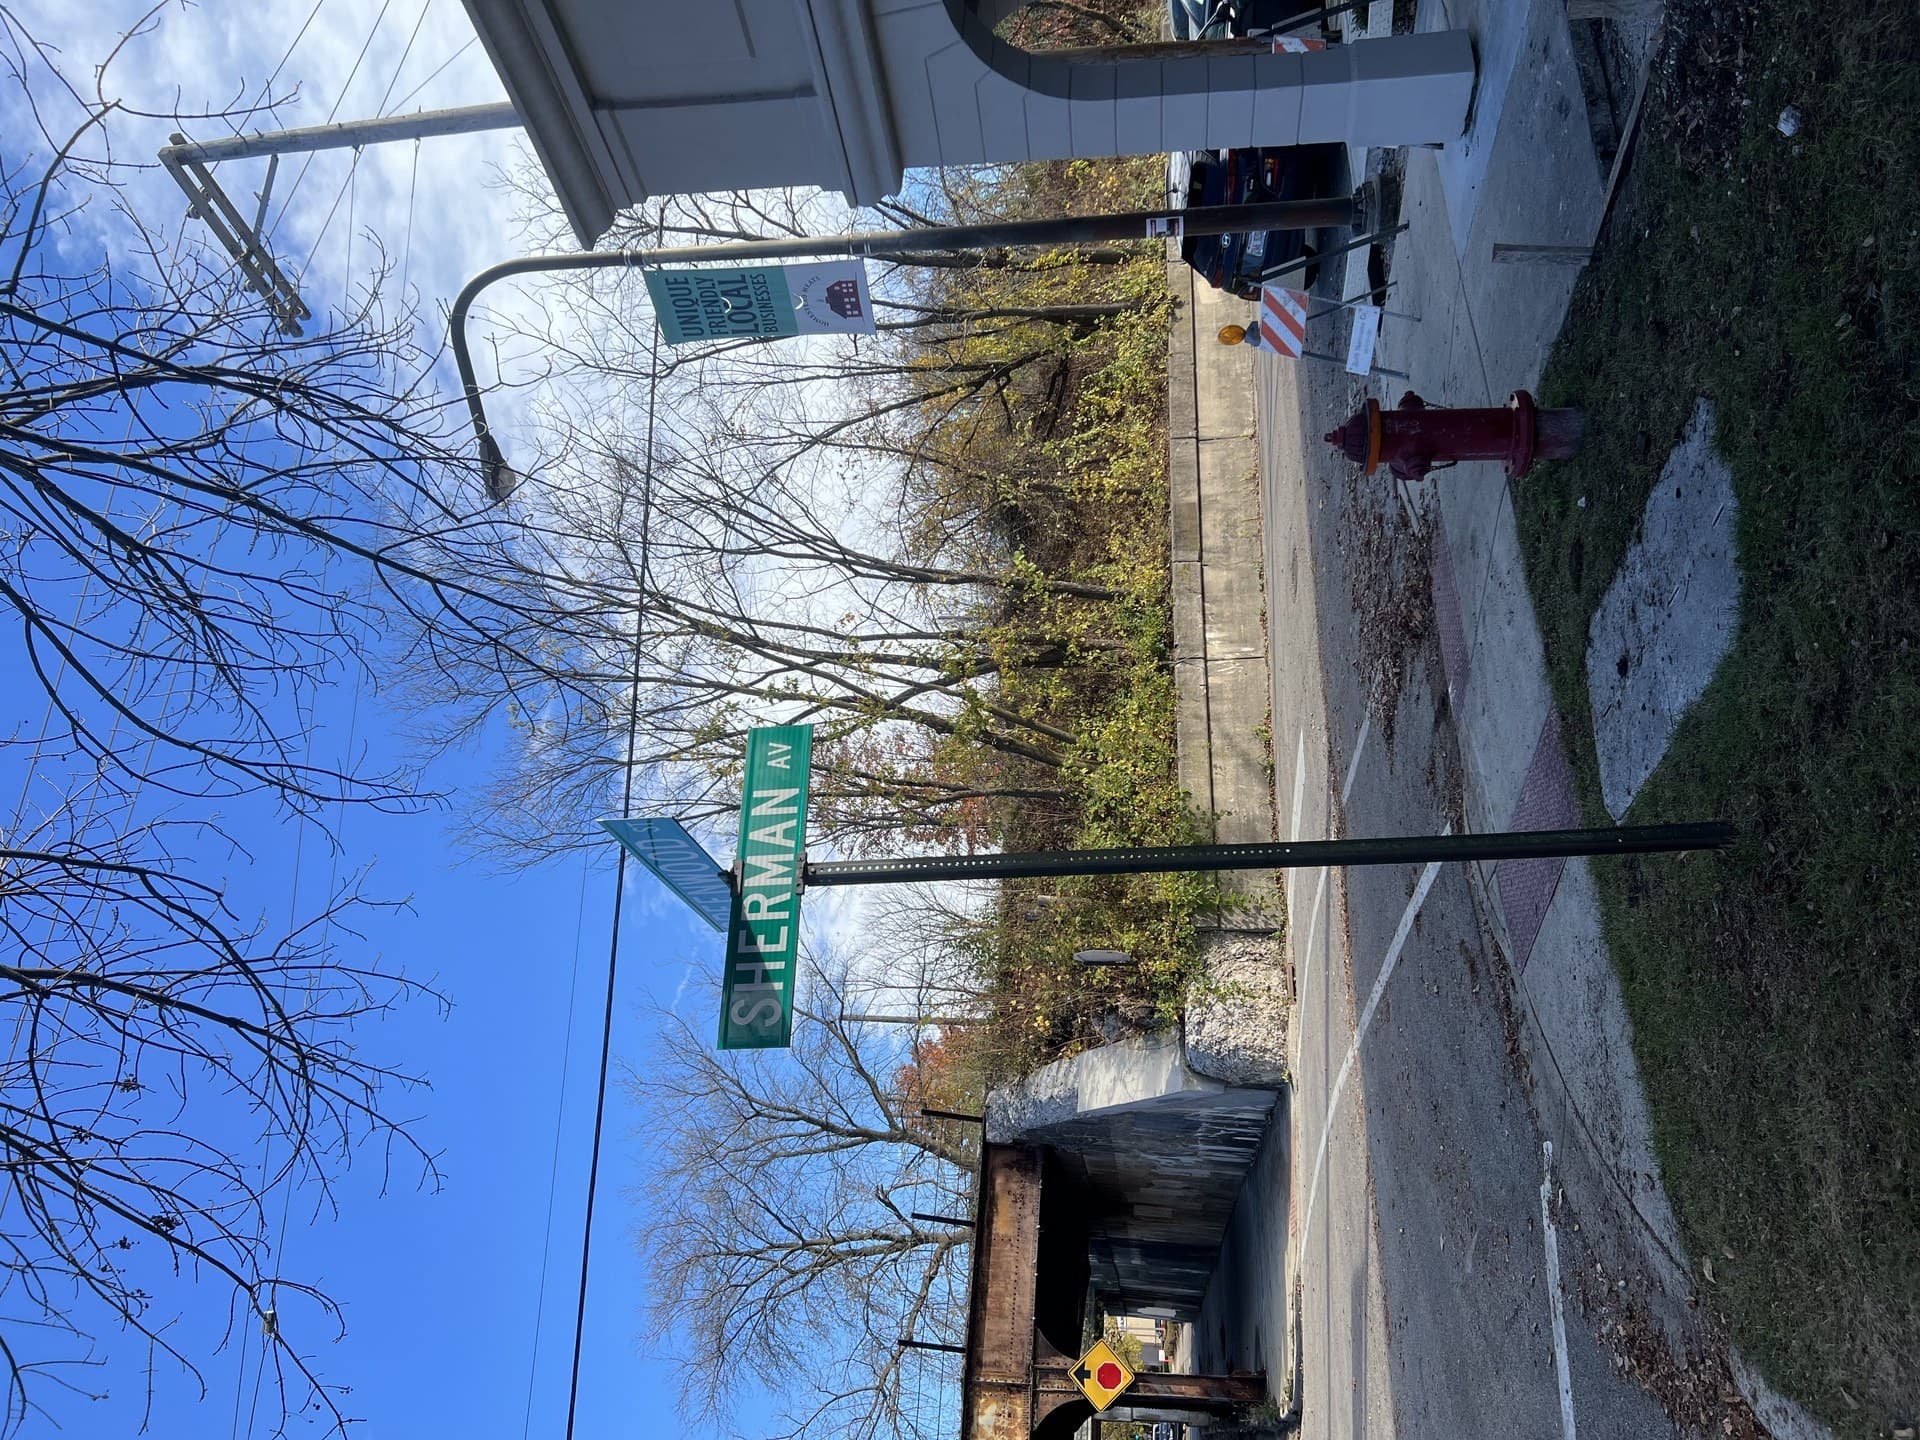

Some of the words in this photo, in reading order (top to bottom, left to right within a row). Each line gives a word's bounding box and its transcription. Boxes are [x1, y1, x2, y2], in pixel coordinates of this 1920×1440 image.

[665, 276, 704, 337] UNIQUE
[696, 277, 728, 336] FRIENDLY
[718, 274, 760, 335] LOCAL
[750, 272, 779, 334] BUSINESSES
[802, 294, 830, 328] HOMESTEAD
[626, 821, 661, 833] ST
[635, 838, 731, 930] EENWOOD
[730, 787, 800, 1028] SHERMAN
[767, 742, 793, 770] AV
